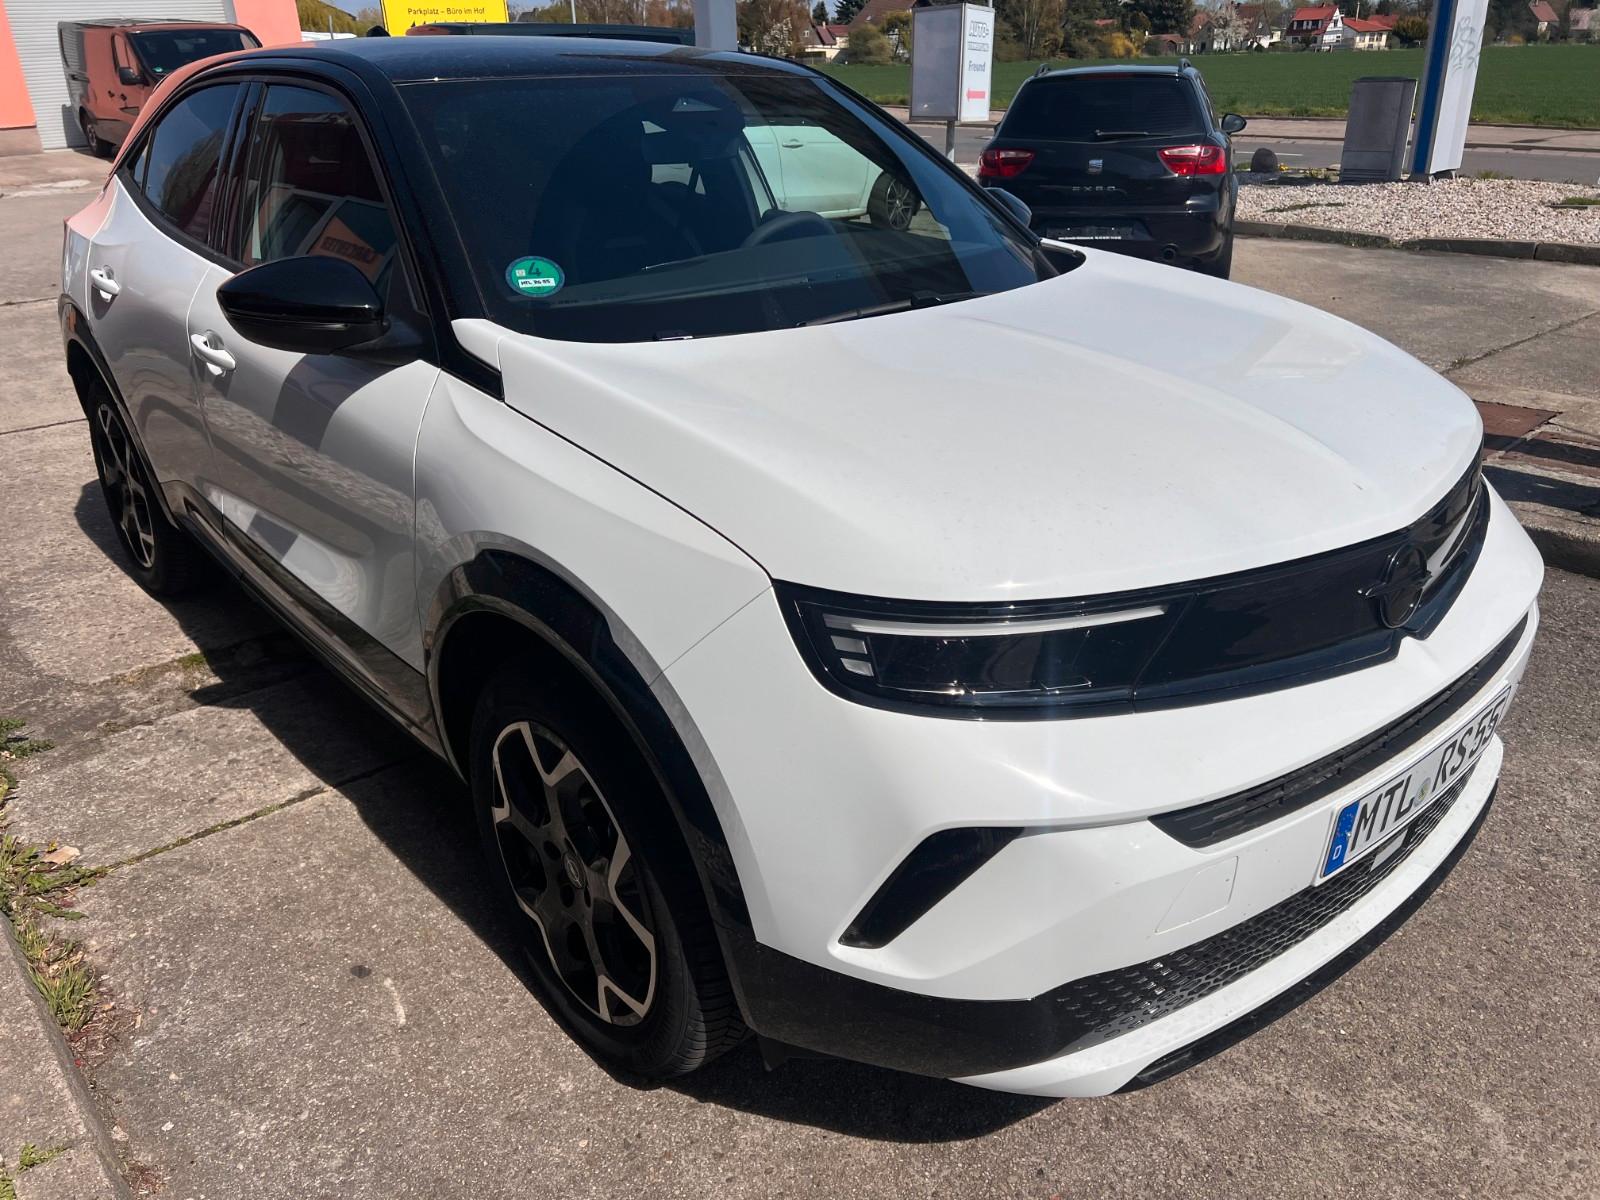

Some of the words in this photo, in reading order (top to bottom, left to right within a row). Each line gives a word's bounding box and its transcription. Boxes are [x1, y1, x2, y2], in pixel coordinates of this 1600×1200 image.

[407, 7, 439, 16] Parkplatz
[446, 7, 463, 15] Büro
[463, 7, 473, 15] im
[473, 7, 485, 15] Hof
[968, 60, 986, 72] Freund
[528, 262, 541, 276] 4
[1350, 774, 1415, 852] MTL
[1432, 726, 1474, 792] RS
[1469, 697, 1506, 759] 55
[1333, 845, 1342, 860] D
